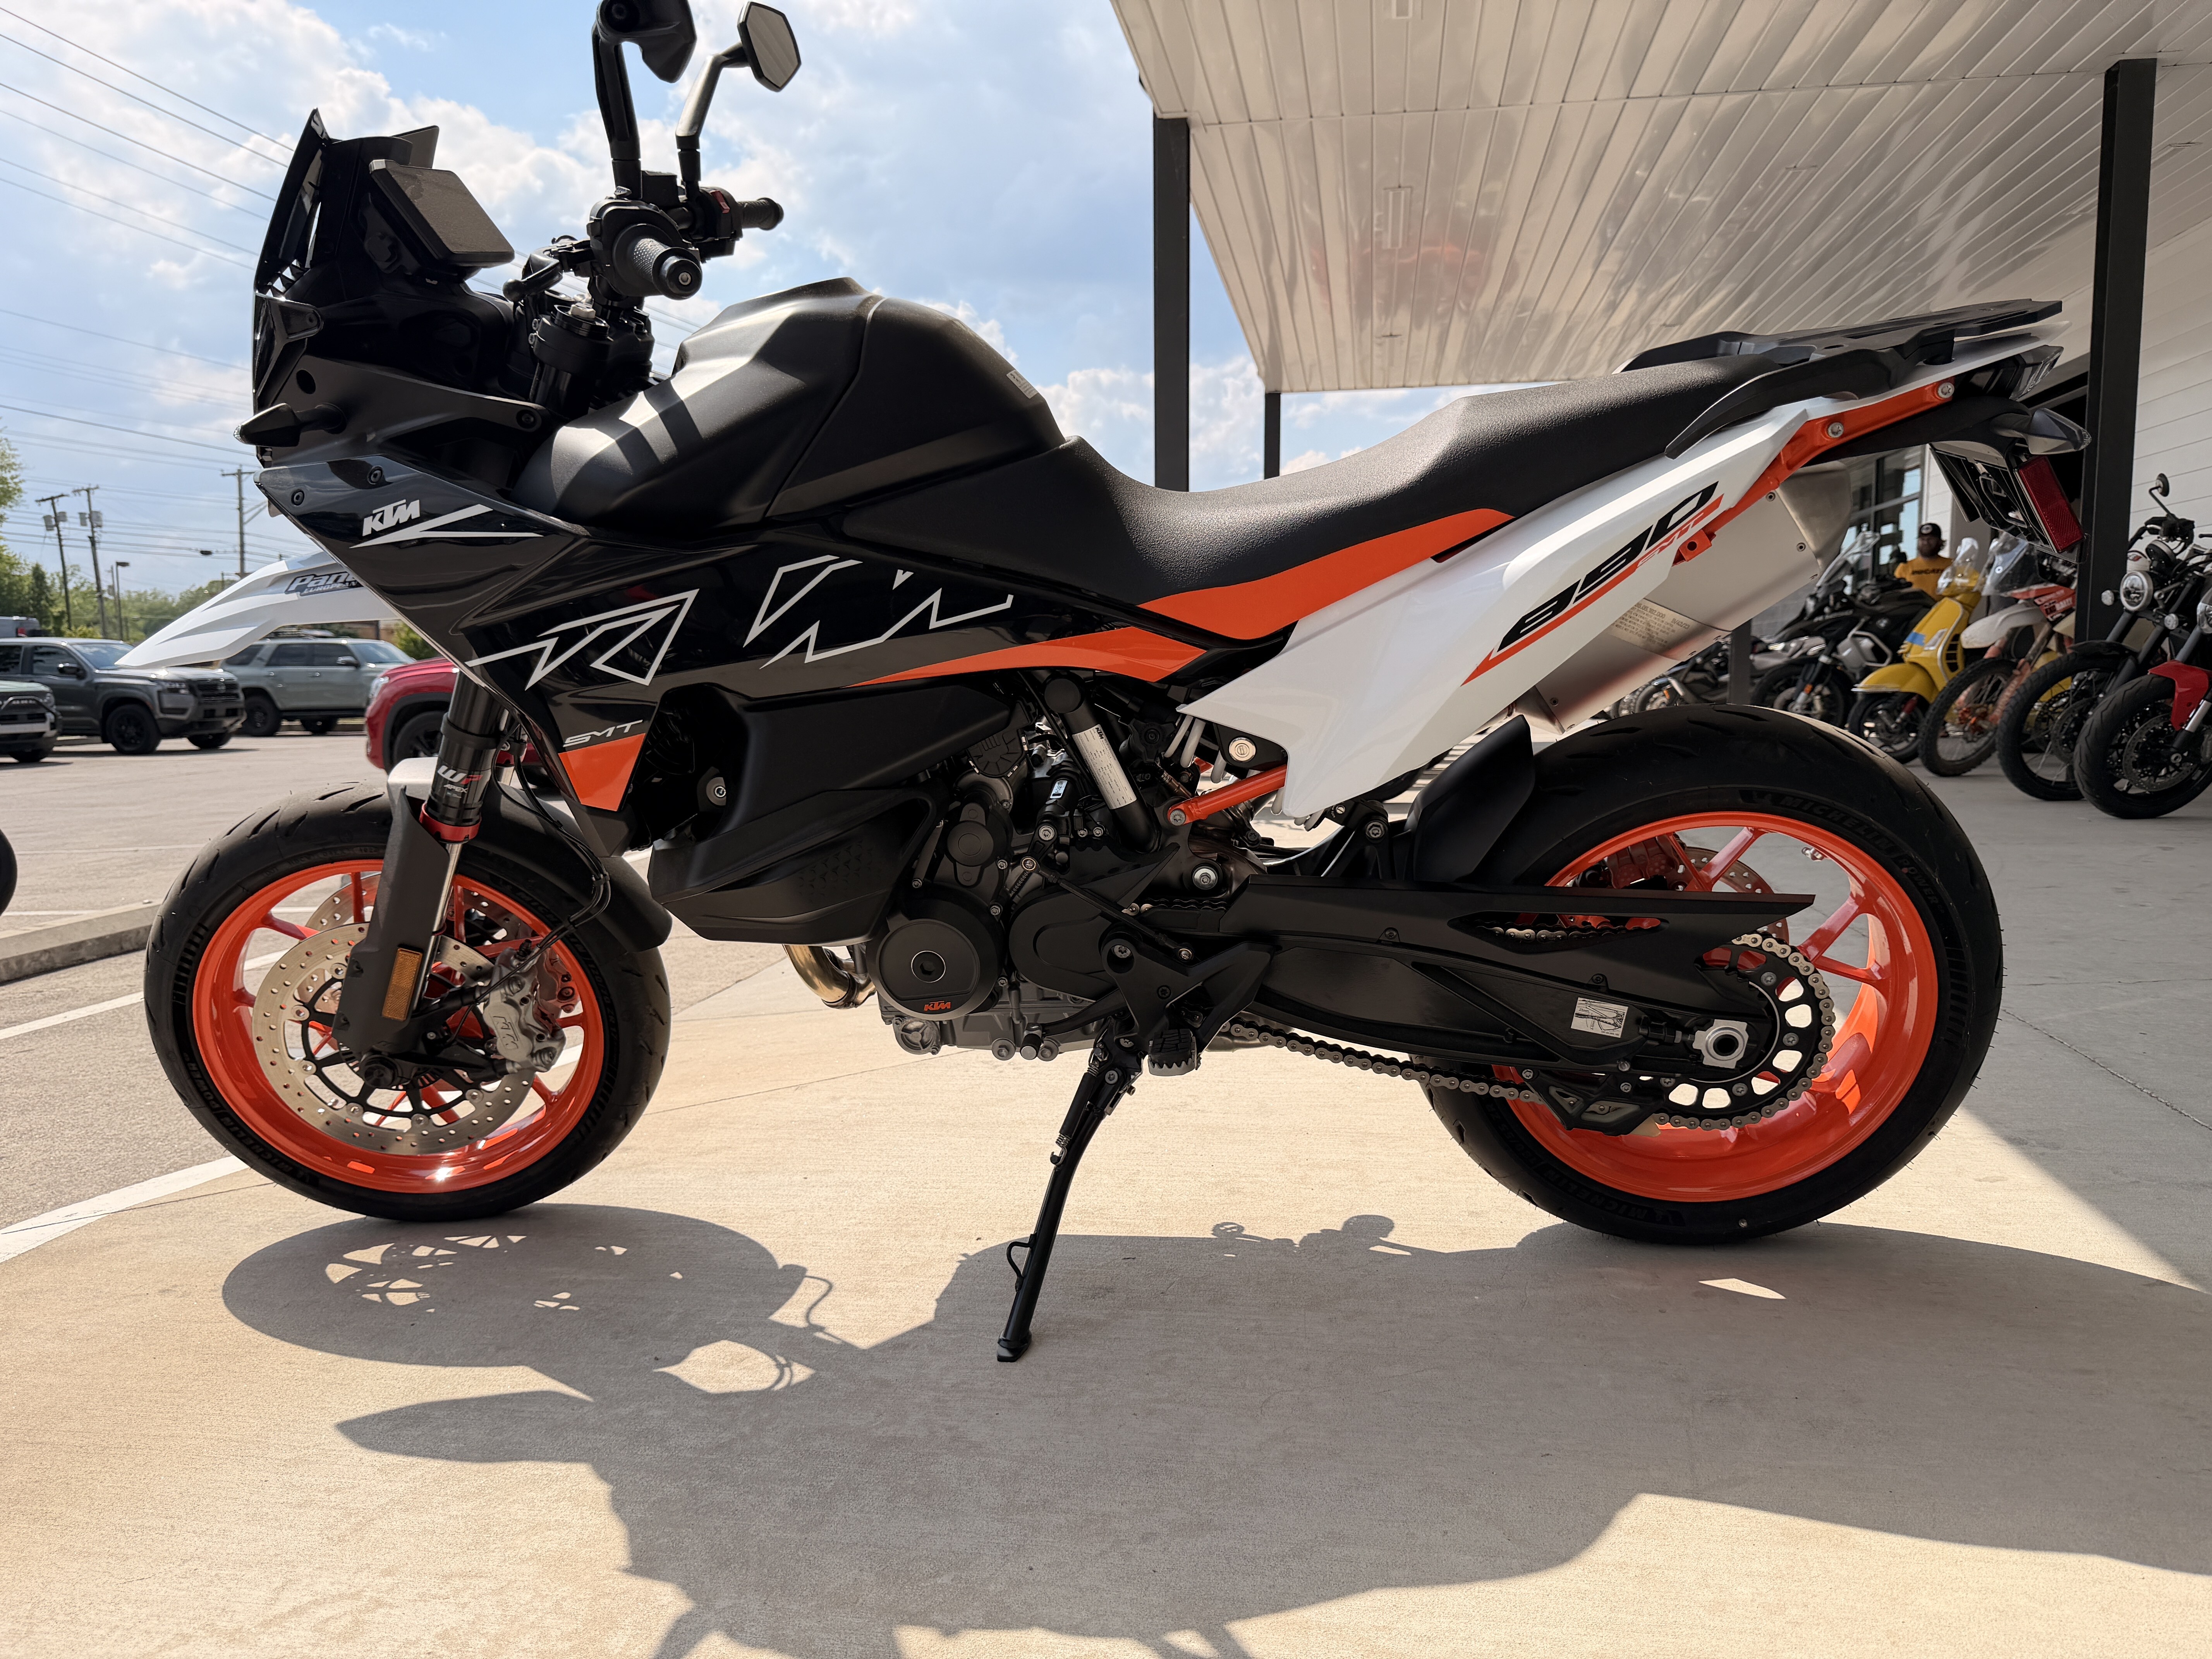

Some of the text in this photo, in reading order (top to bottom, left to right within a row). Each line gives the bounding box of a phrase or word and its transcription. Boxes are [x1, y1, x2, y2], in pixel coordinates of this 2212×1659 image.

[362, 499, 420, 536] KTM
[563, 720, 643, 747] SMT
[437, 765, 483, 784] WP
[443, 784, 468, 793] APEX
[1781, 795, 1895, 851] MICHELIN
[924, 1001, 951, 1012] KTM
